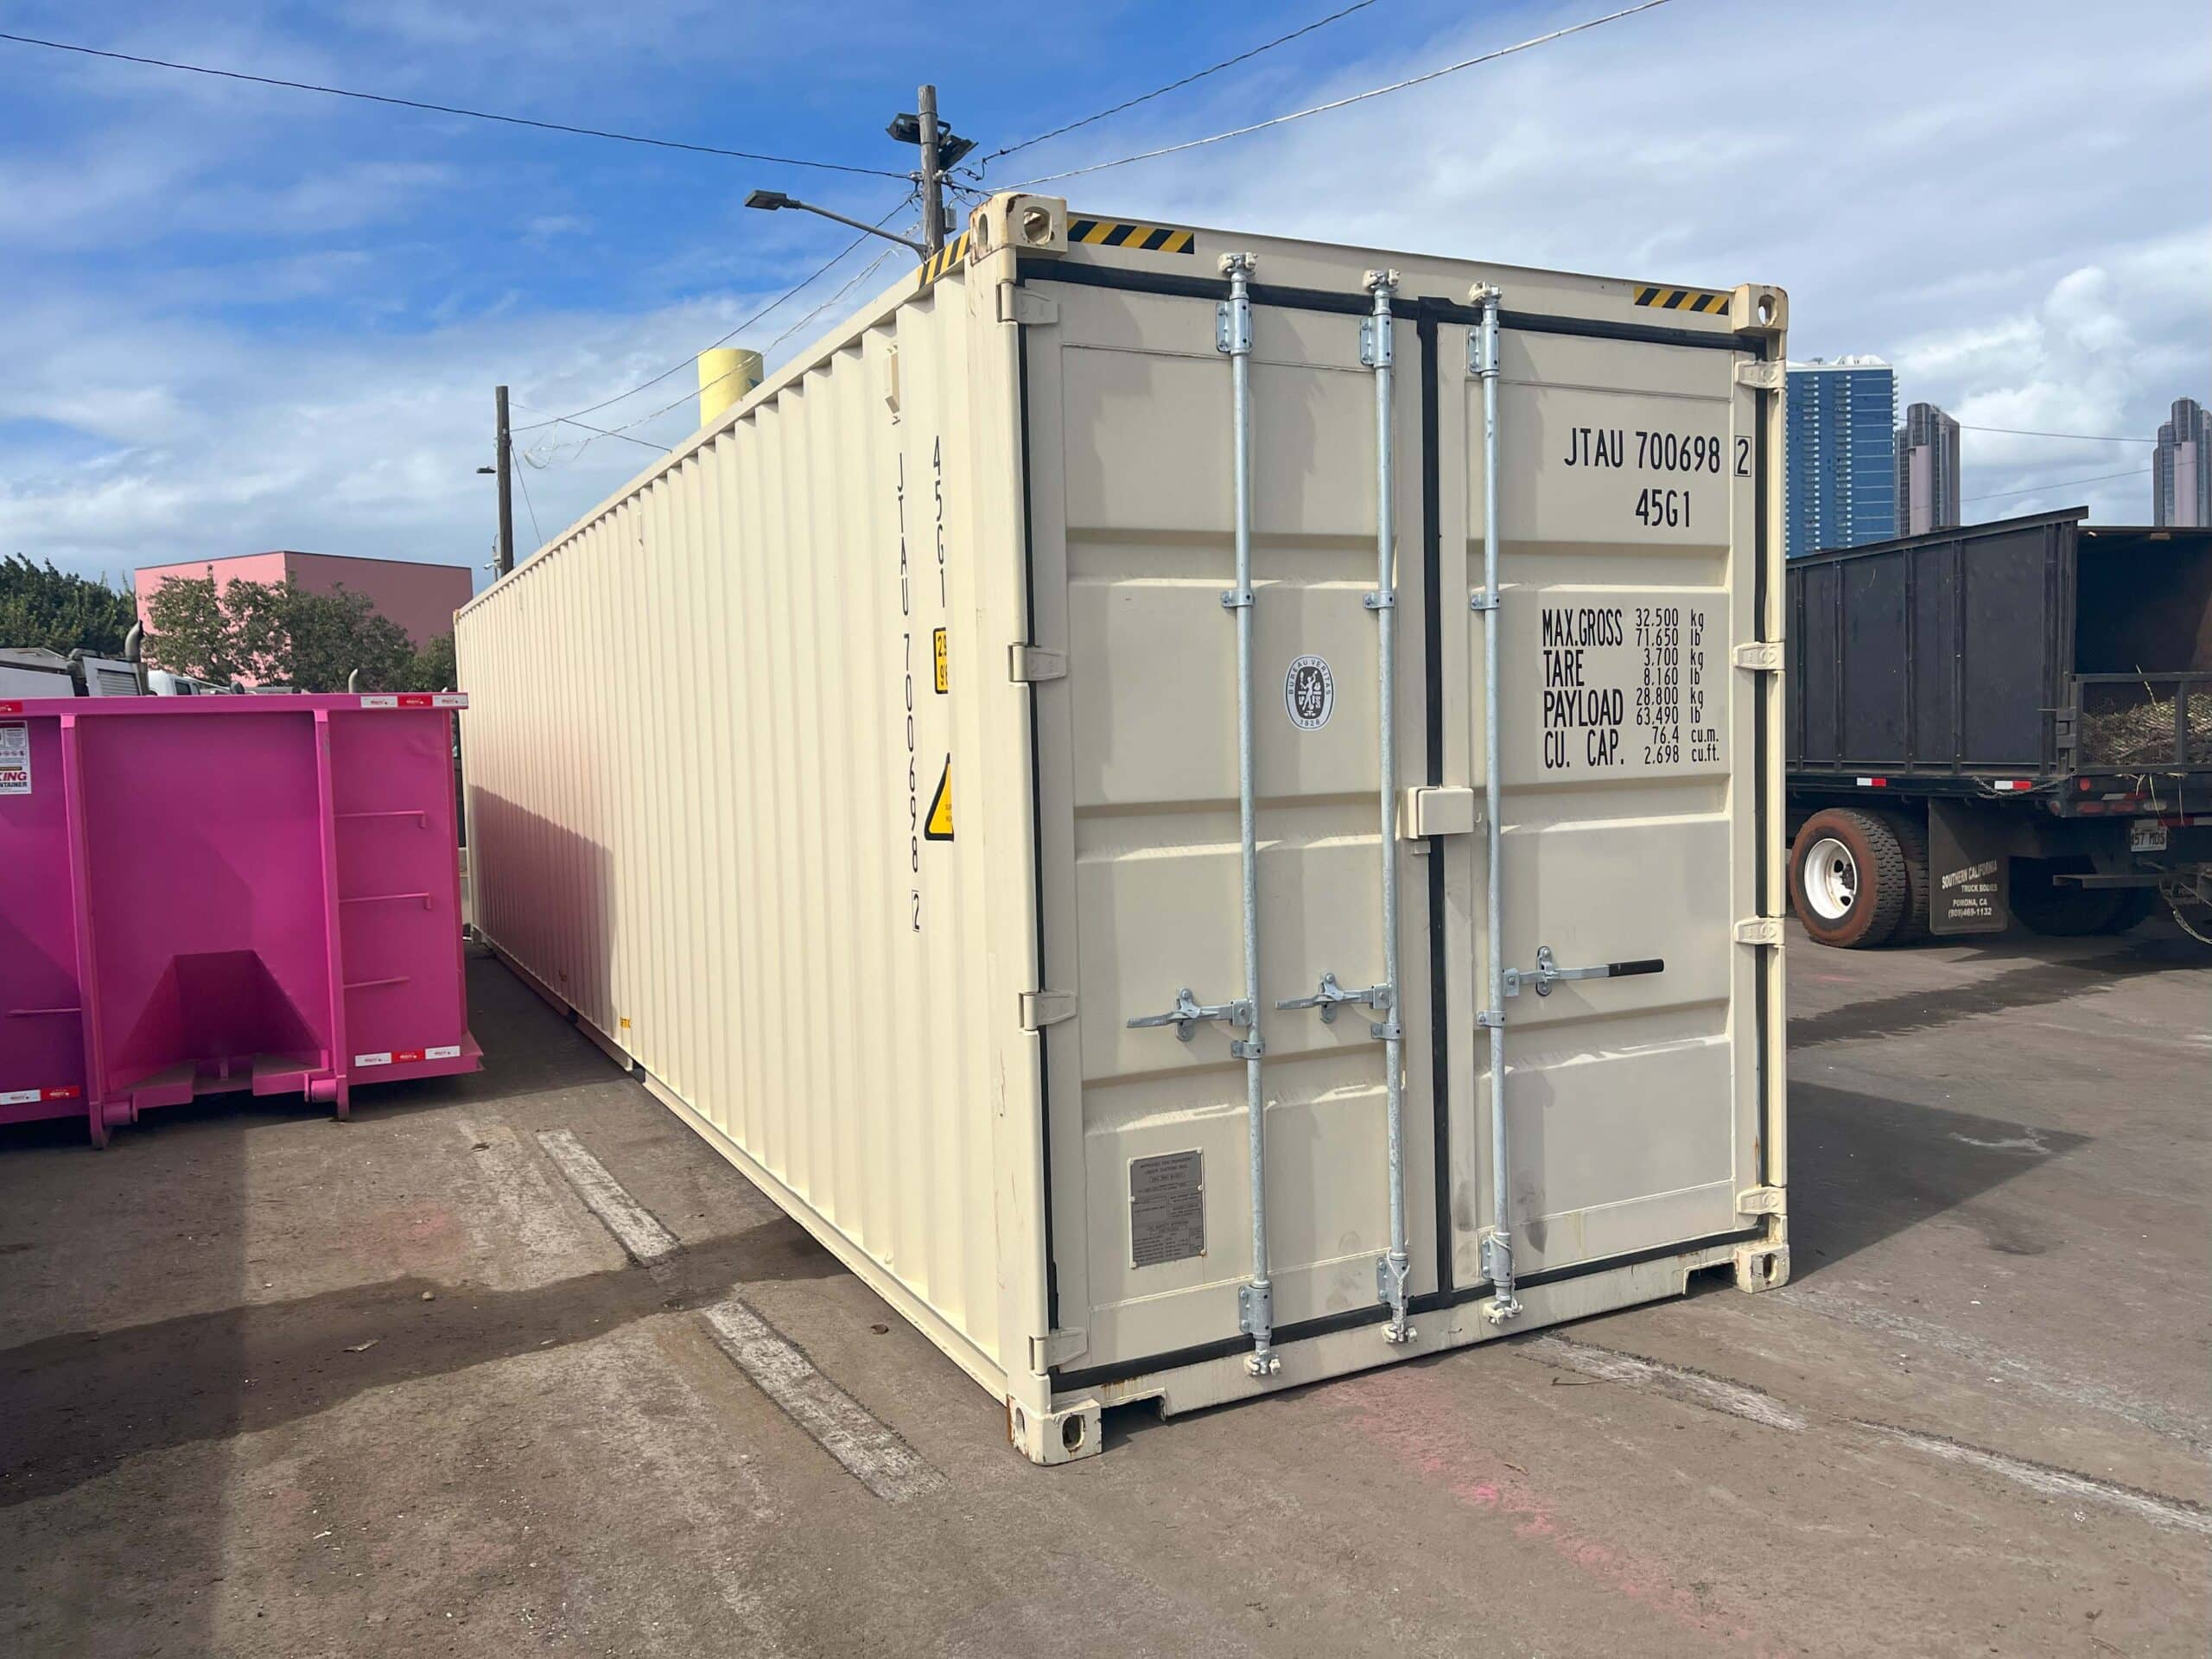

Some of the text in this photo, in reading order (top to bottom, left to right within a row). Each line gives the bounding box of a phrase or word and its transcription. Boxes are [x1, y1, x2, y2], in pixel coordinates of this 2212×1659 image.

[1564, 427, 1750, 475] JTAU 700698 2
[932, 435, 945, 607] 45G1
[1635, 488, 1690, 528] 45G1
[1541, 608, 1624, 647] MAX.GROSS
[1690, 608, 1704, 632] kg
[1690, 628, 1700, 646] lb
[897, 452, 908, 616] JTAU
[903, 632, 918, 873] 700698
[1287, 659, 1332, 695] BUREAU VERITAS
[1543, 650, 1585, 688] TARE
[1690, 648, 1704, 671] kg
[1690, 667, 1700, 685] lb
[1543, 689, 1624, 728] PAYLOAD
[1690, 687, 1704, 709] kg
[1690, 707, 1700, 724] lb
[1544, 726, 1719, 769] CU. CAP. 76.4 cu.m.
[1691, 743, 1719, 762] cu.ft.
[1942, 868, 1968, 890] SOUTHERN
[1961, 884, 1979, 893] TRUCK
